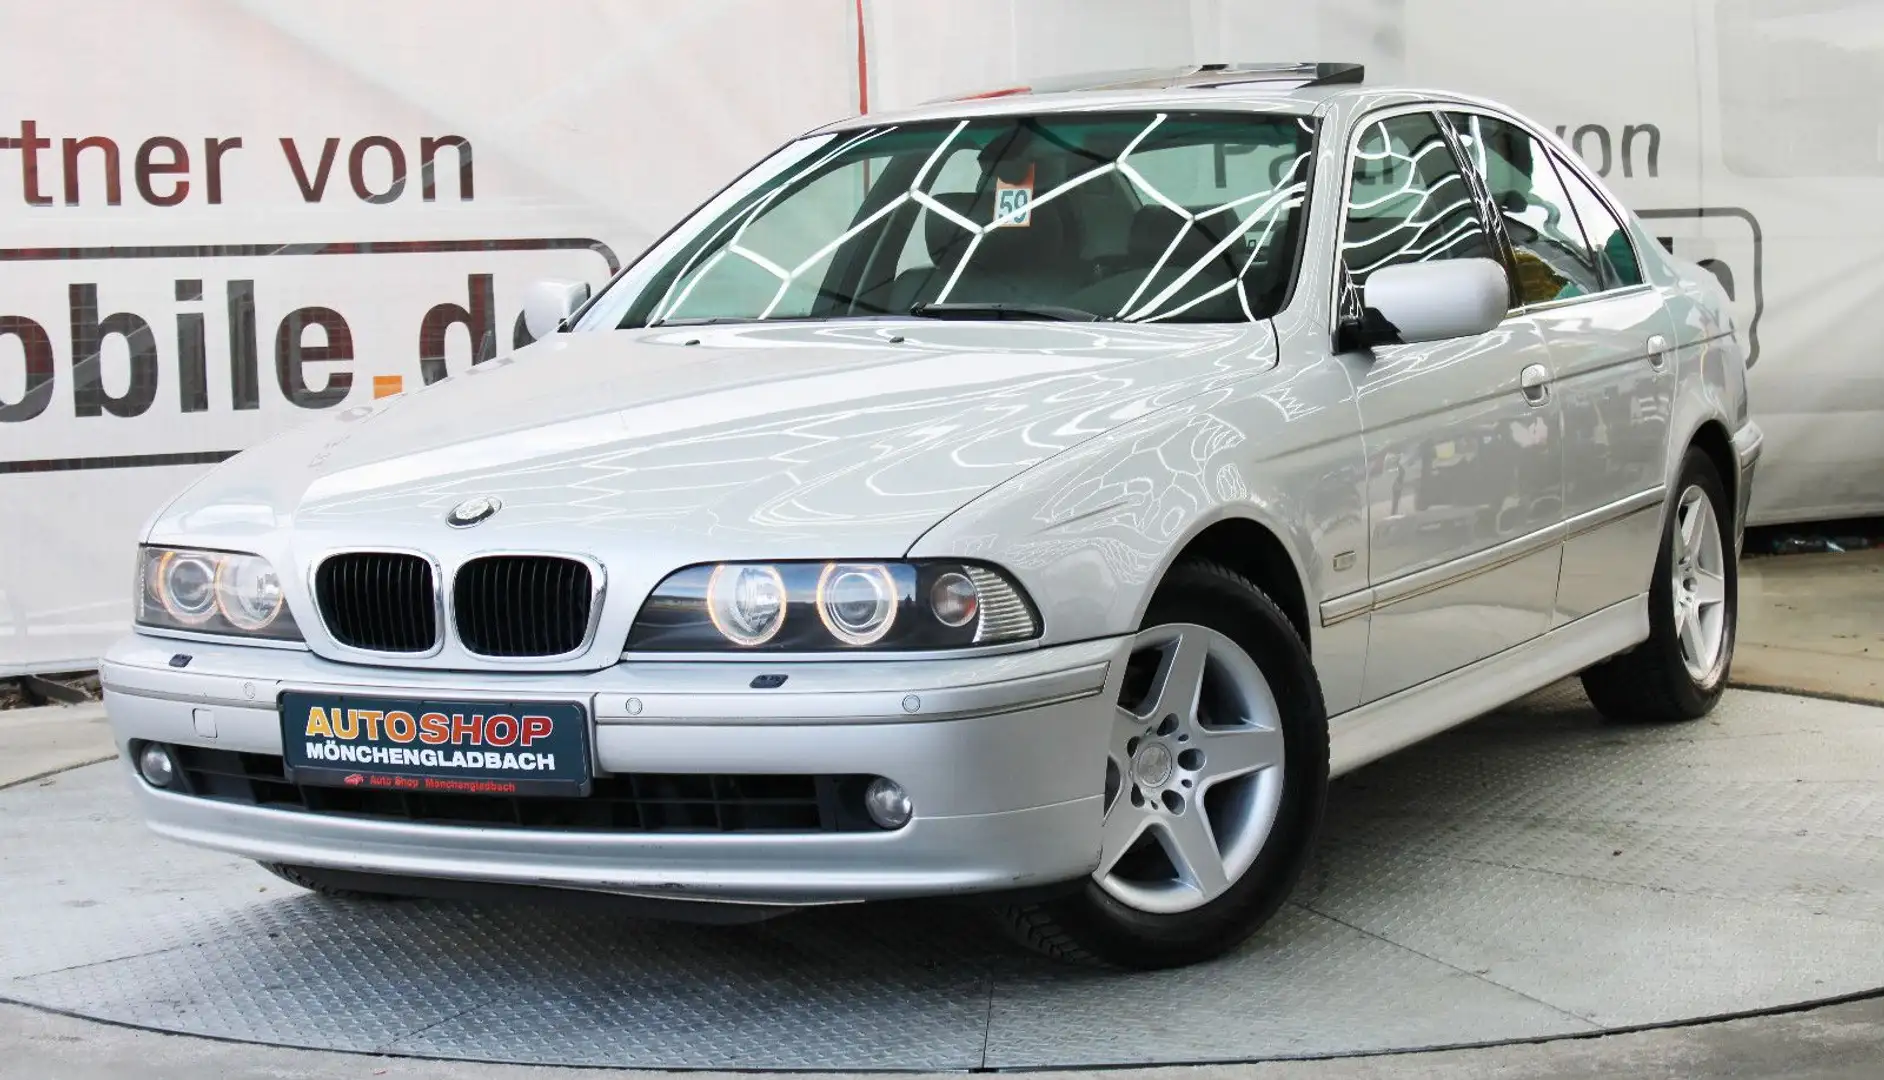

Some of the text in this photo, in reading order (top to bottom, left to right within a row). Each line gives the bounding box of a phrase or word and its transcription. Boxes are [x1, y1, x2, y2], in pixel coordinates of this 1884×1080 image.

[0, 120, 474, 206] tner von
[1555, 123, 1661, 178] on
[998, 189, 1028, 223] 59
[306, 740, 555, 771] MÖNCHENGLADBACH
[369, 775, 392, 787] Auto
[395, 776, 419, 789] Shop
